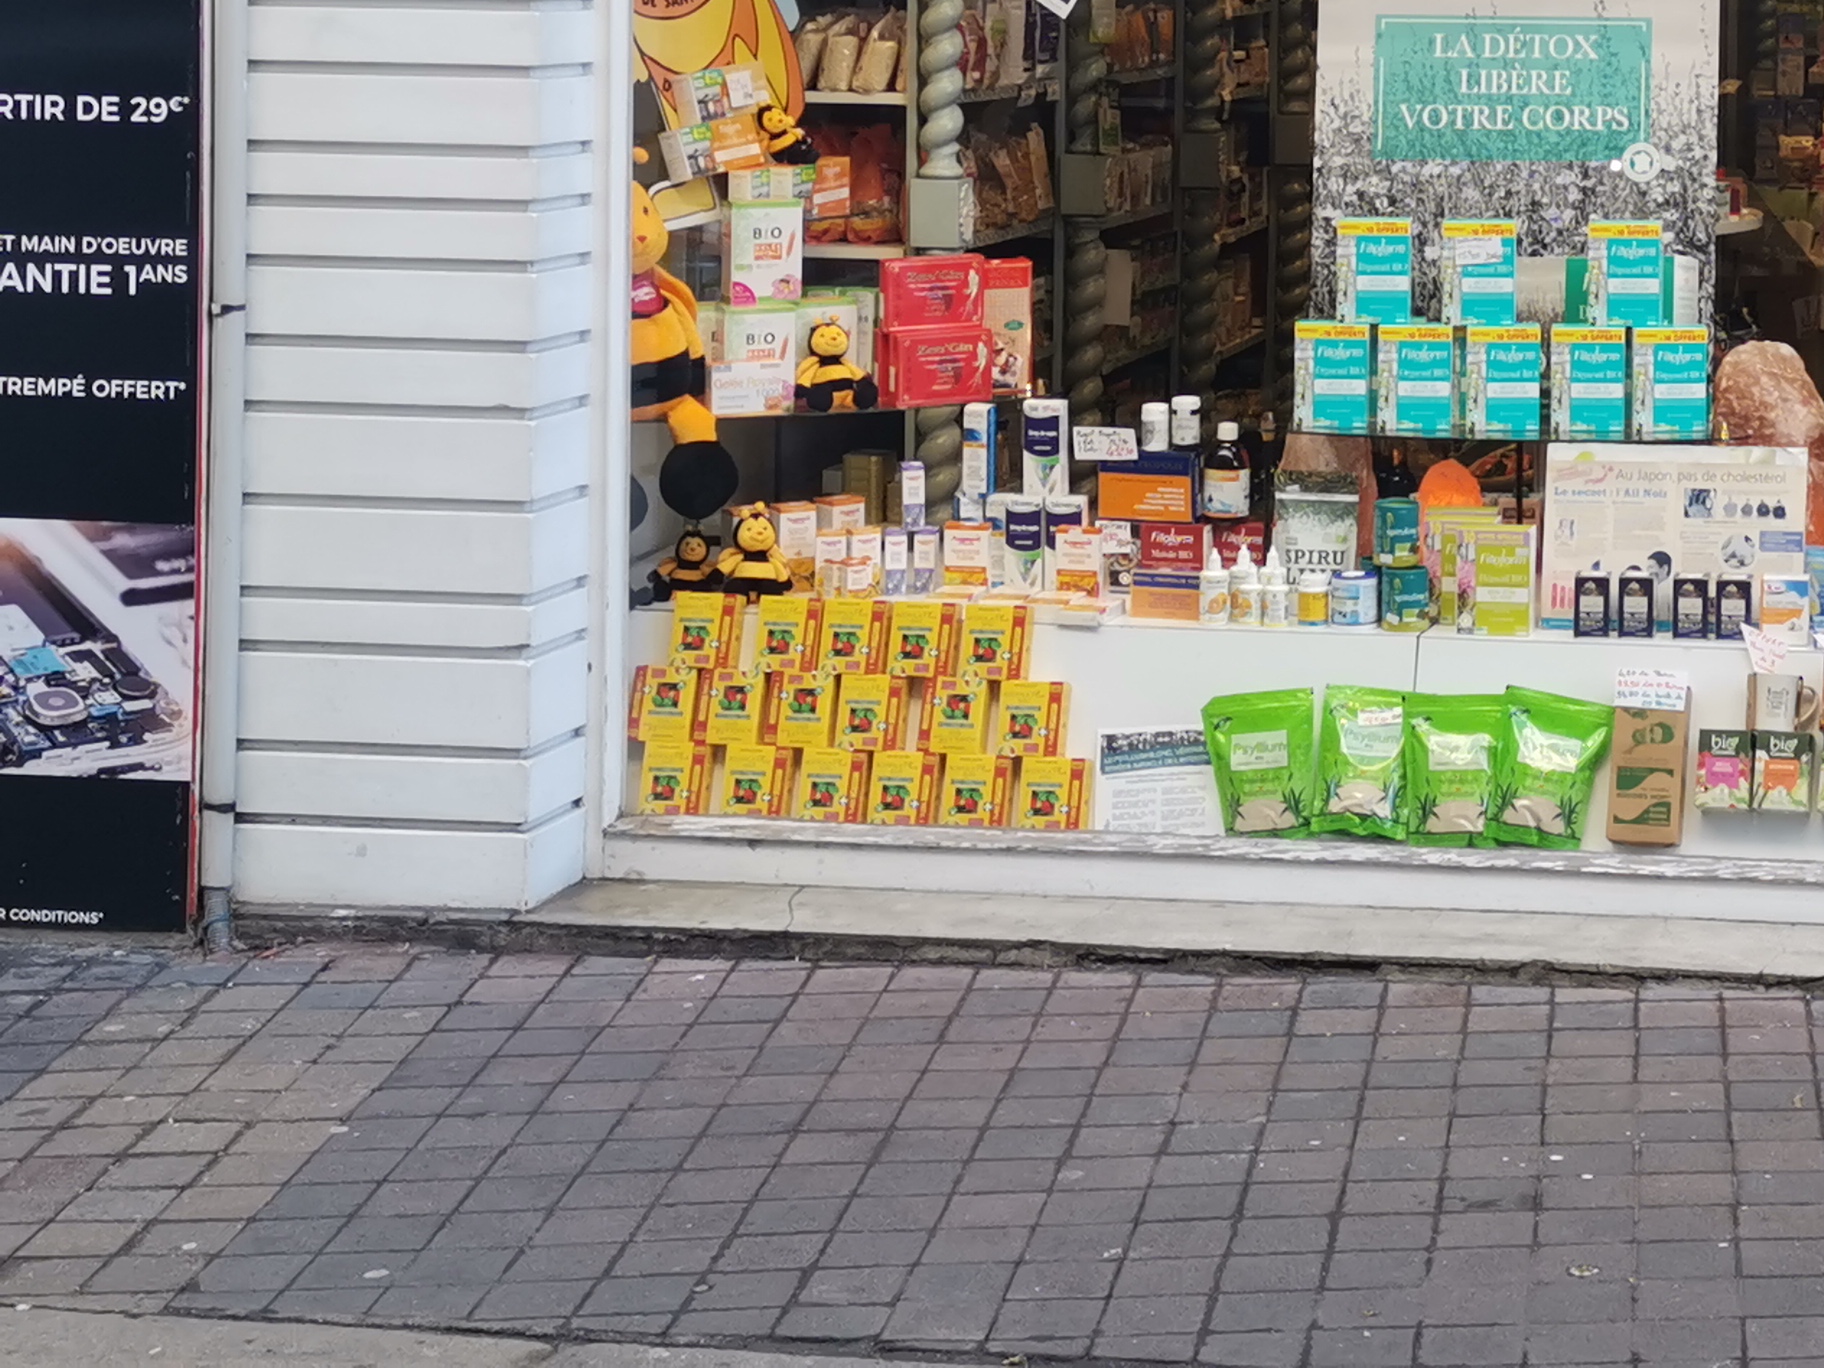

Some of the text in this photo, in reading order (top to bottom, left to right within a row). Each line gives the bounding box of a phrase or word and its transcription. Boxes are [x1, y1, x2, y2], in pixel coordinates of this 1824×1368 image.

[1434, 27, 1600, 60] LA DÉTOX
[1460, 64, 1572, 96] LIBÈRE
[77, 95, 120, 122] DE
[1399, 104, 1630, 131] VOTRE CORPS
[753, 227, 782, 239] BIO
[21, 235, 75, 253] MAIN
[82, 236, 188, 256] D'OEUVRE
[746, 332, 775, 345] BIO
[1615, 469, 1633, 481] Au
[1677, 471, 1698, 485] pas
[1701, 469, 1716, 482] de
[1721, 470, 1787, 483] cholestérol
[1286, 549, 1346, 565] SPIRU
